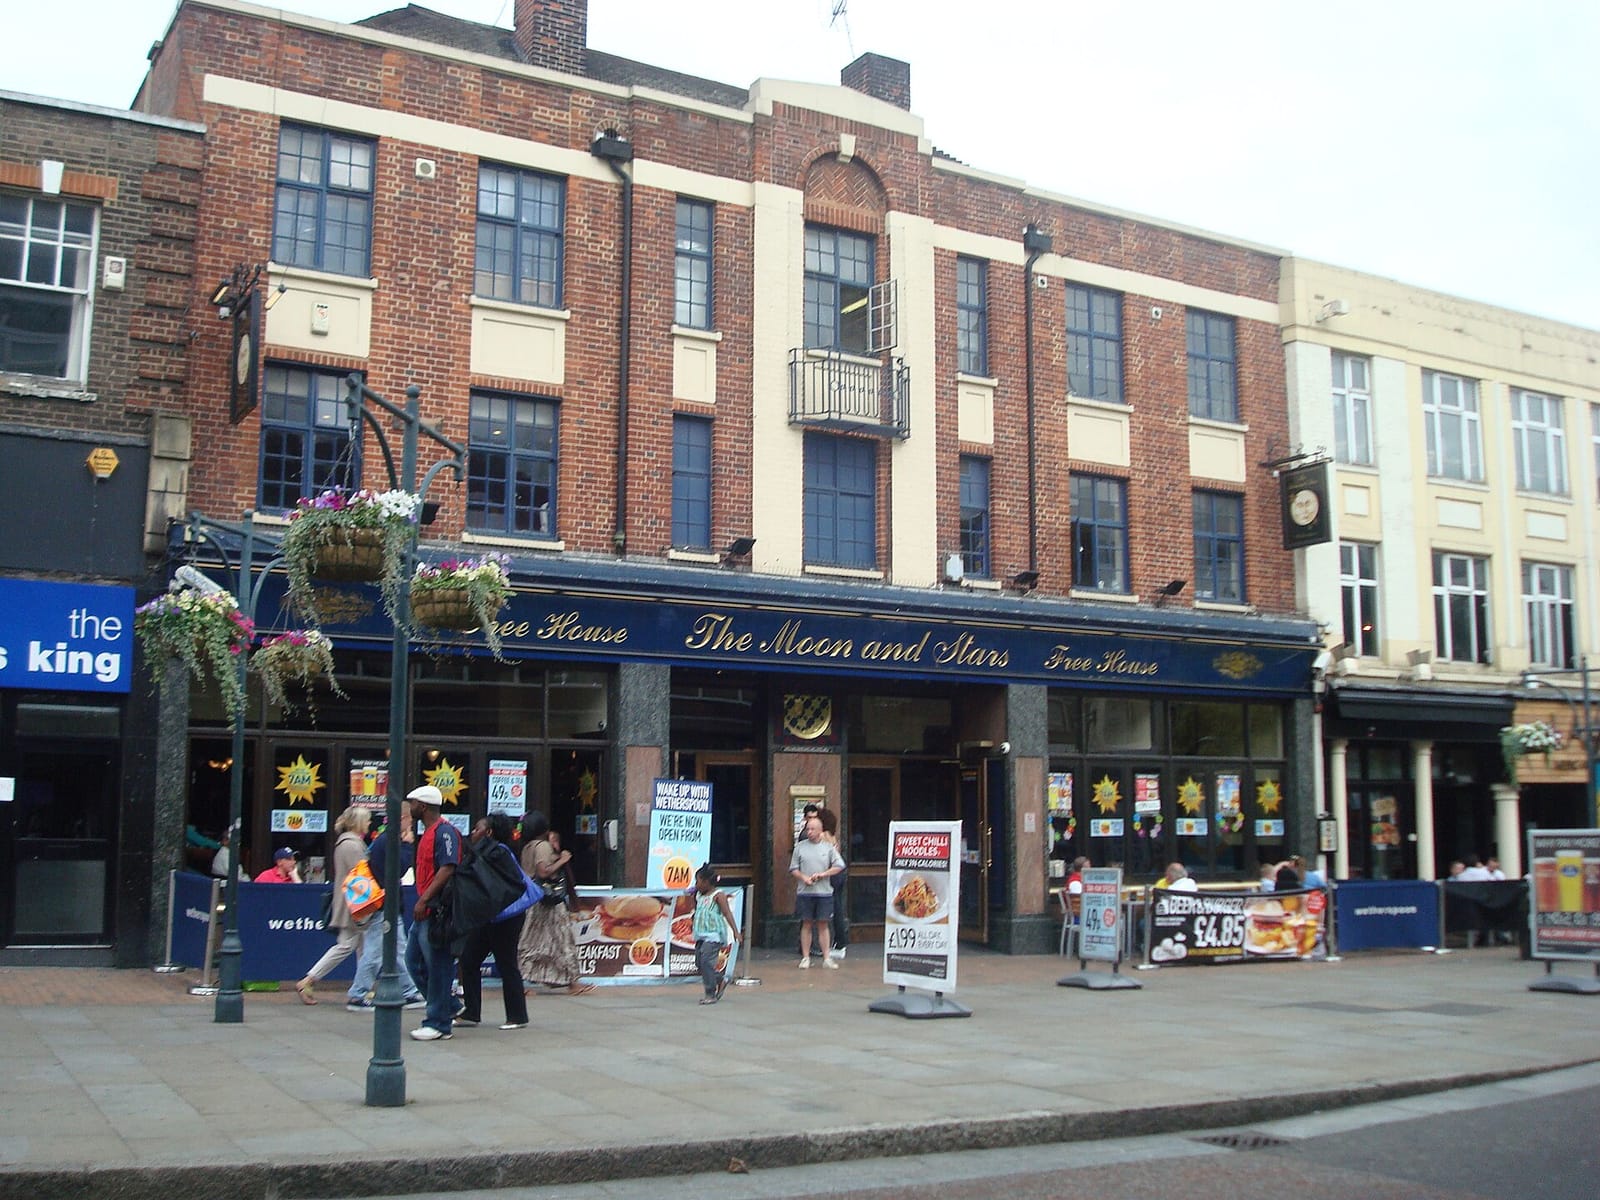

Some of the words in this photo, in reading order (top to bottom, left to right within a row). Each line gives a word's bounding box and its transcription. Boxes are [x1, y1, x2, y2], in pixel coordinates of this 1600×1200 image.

[68, 607, 122, 641] the
[537, 610, 628, 644] House
[685, 613, 753, 651] The
[759, 618, 854, 659] Moon
[861, 631, 932, 662] and
[933, 631, 1010, 668] Stars
[28, 640, 121, 683] king
[1043, 644, 1093, 672] Free
[1096, 649, 1160, 676] House
[656, 782, 679, 797] WAKE
[679, 785, 690, 798] UP
[690, 785, 710, 800] WITH
[655, 796, 709, 812] WETHERSPOON
[659, 814, 684, 828] WE'RE
[684, 815, 703, 830] NOW
[658, 828, 679, 841] OPEN
[680, 829, 702, 842] FROM
[897, 836, 922, 847] SWEET
[922, 836, 949, 847] CHILLI
[901, 846, 938, 857] NOODLES
[667, 866, 690, 883] 7AM
[1193, 915, 1245, 947] £4.85
